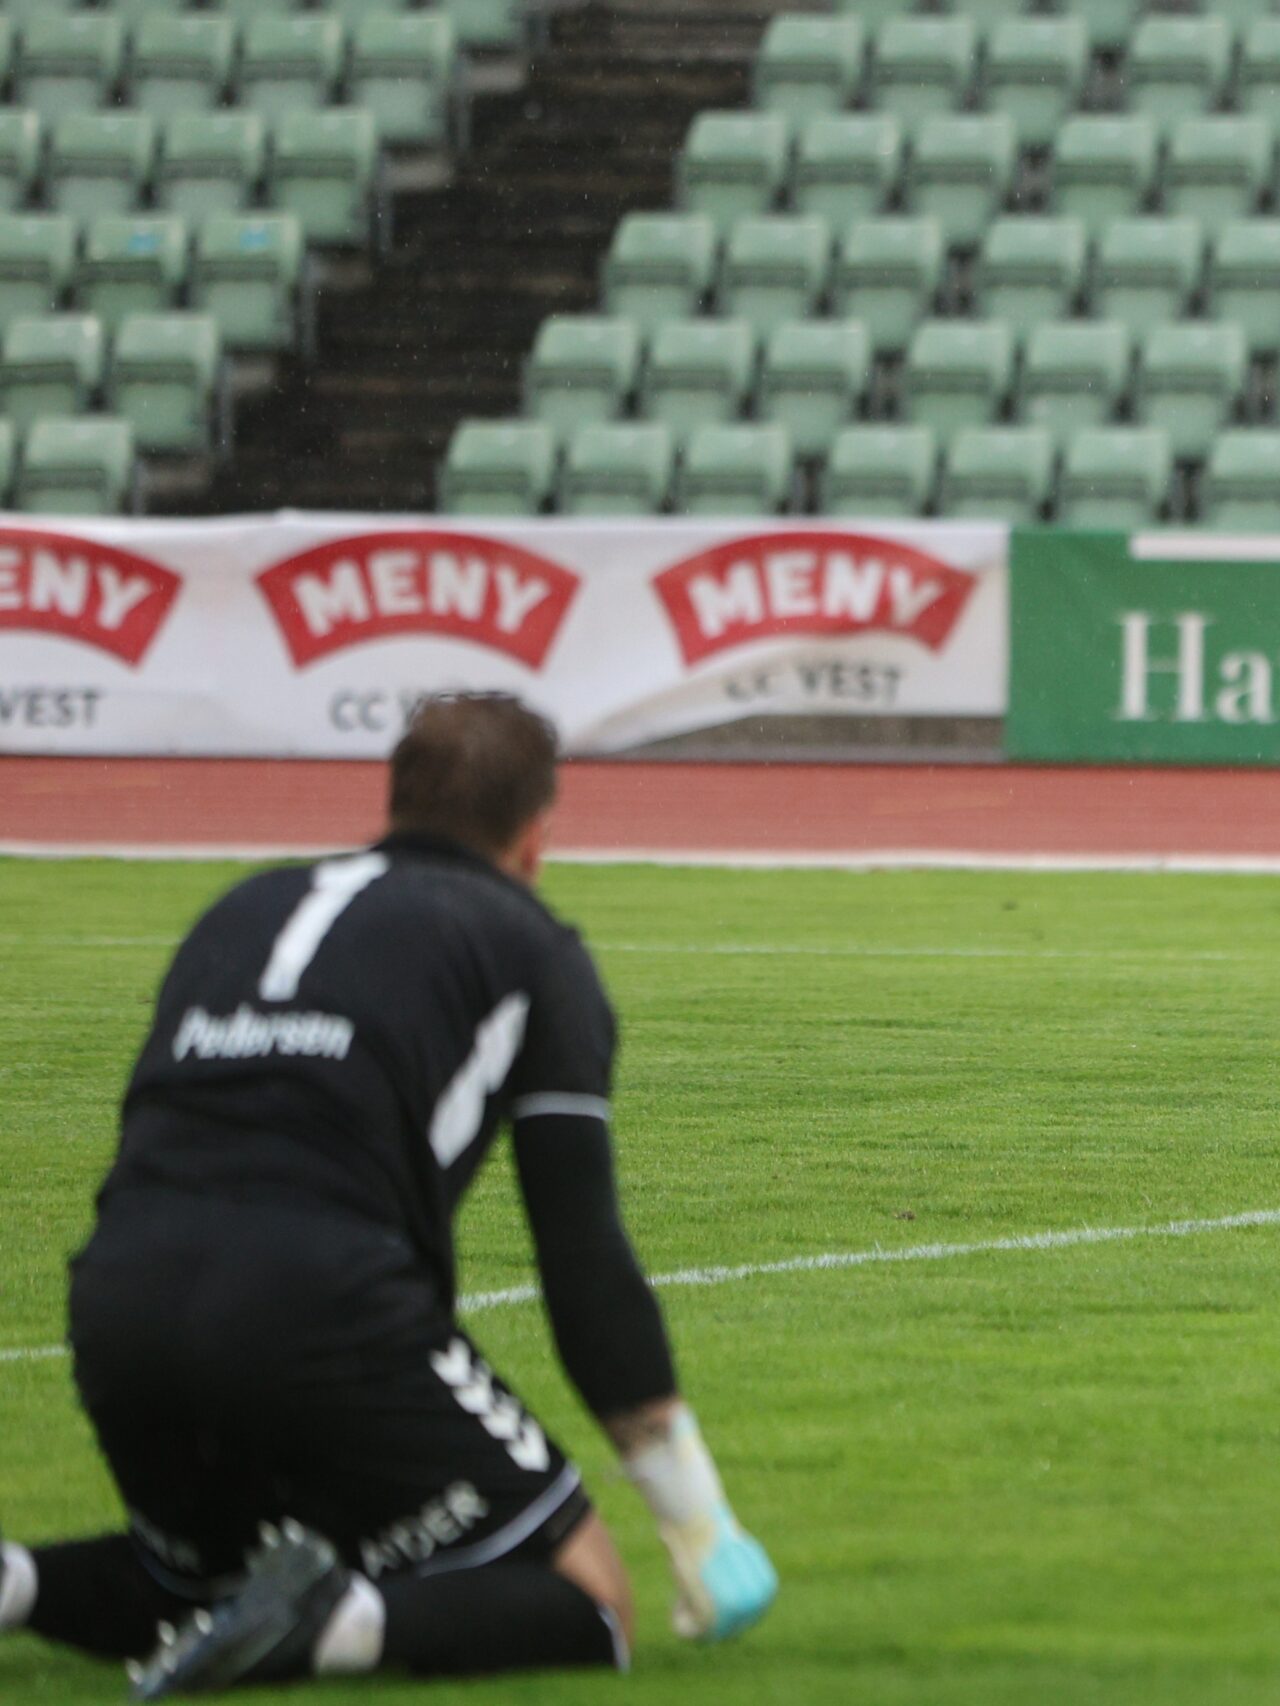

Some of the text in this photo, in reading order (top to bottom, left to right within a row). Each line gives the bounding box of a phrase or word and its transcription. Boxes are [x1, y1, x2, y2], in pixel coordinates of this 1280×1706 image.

[292, 550, 550, 638] MENY
[686, 551, 944, 639] MENY
[328, 686, 388, 734] CC
[797, 659, 902, 702] VEST
[258, 850, 390, 1000] 1
[172, 1001, 355, 1062] Pedersen
